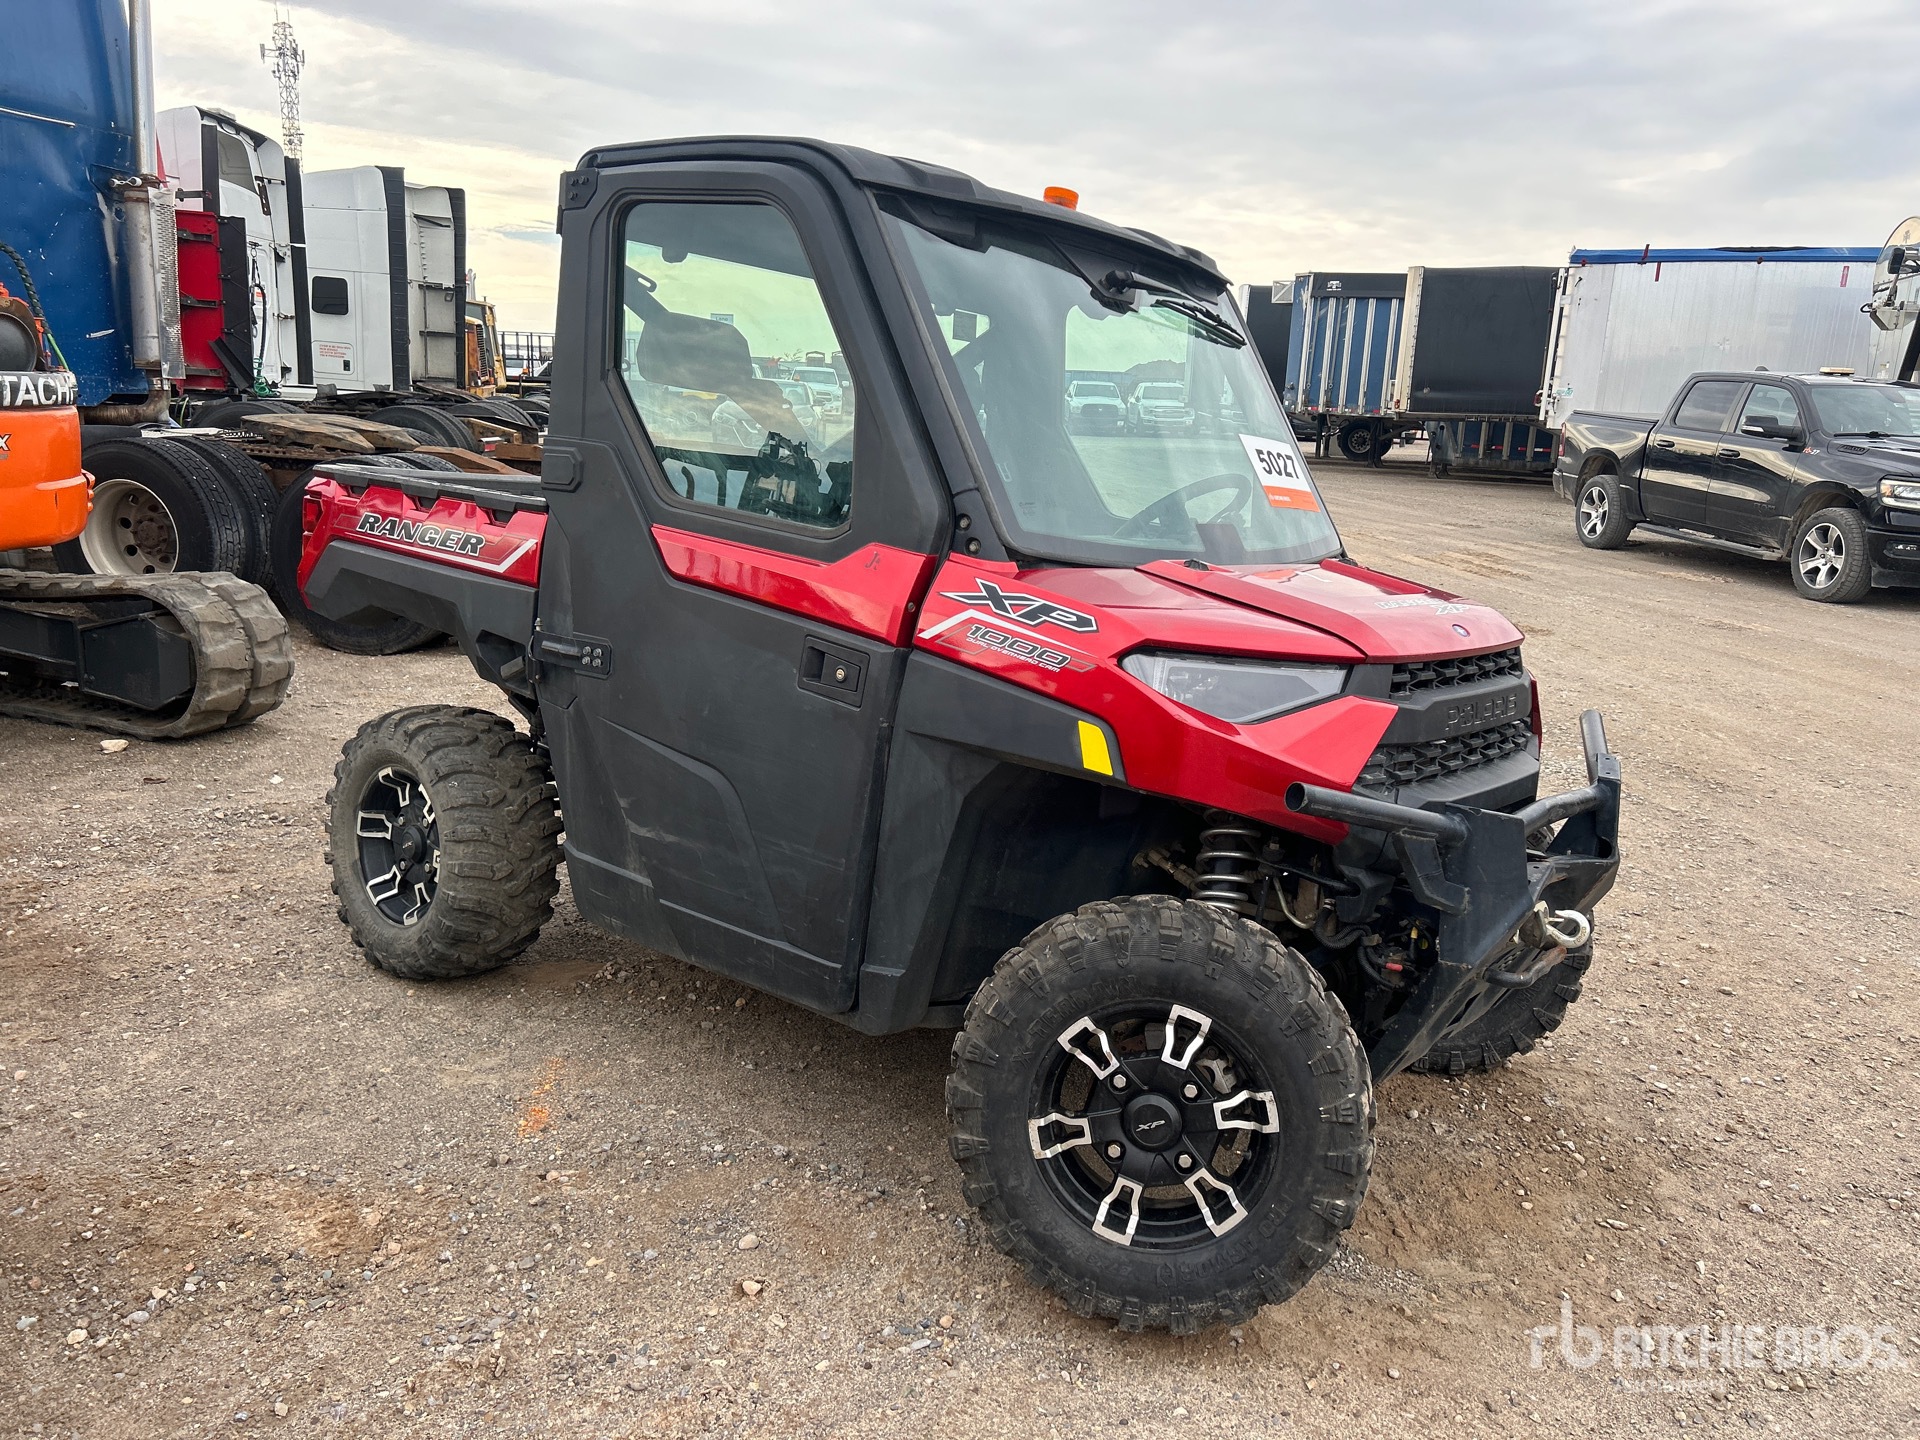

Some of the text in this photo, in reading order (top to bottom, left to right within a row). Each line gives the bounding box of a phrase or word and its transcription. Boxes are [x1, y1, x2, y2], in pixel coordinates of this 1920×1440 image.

[1255, 448, 1299, 479] 5027
[356, 512, 486, 557] RANGER
[938, 577, 1100, 633] XP
[966, 623, 1071, 667] 1000
[966, 637, 1061, 673] DUAL OVERHEAD CAM
[1446, 693, 1517, 730] POLARIS
[1136, 1120, 1166, 1131] XP
